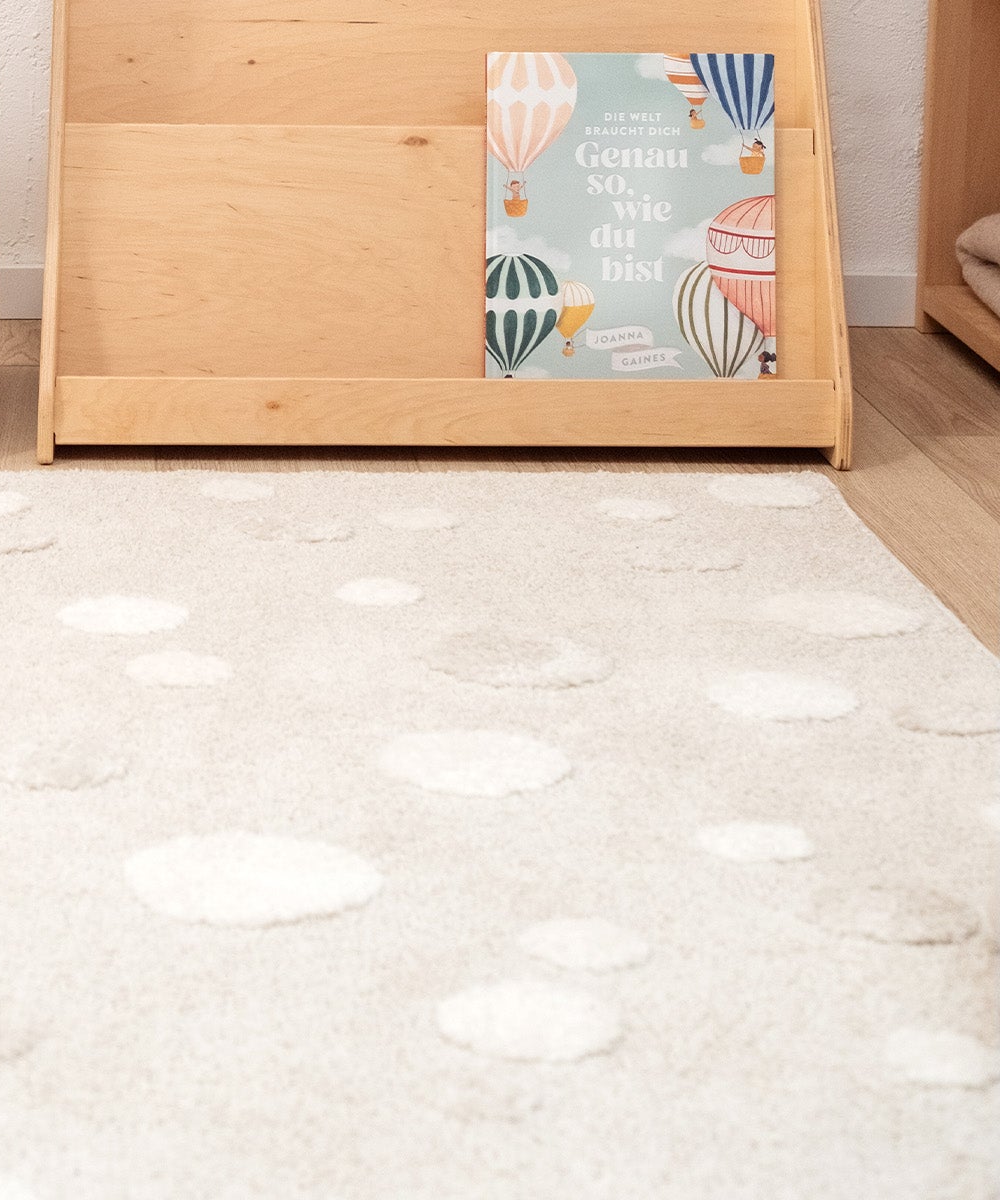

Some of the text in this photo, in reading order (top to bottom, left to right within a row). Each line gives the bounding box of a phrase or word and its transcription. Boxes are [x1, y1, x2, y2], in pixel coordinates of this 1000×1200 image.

[604, 112, 662, 122] DIE WELT
[585, 126, 681, 136] BRAUCHT DICH
[575, 140, 689, 169] Genau
[586, 173, 635, 198] so,
[611, 193, 673, 222] wie
[590, 222, 636, 249] du
[601, 253, 666, 283] bist
[594, 332, 644, 344] JOANNA
[621, 353, 666, 366] GAINES
